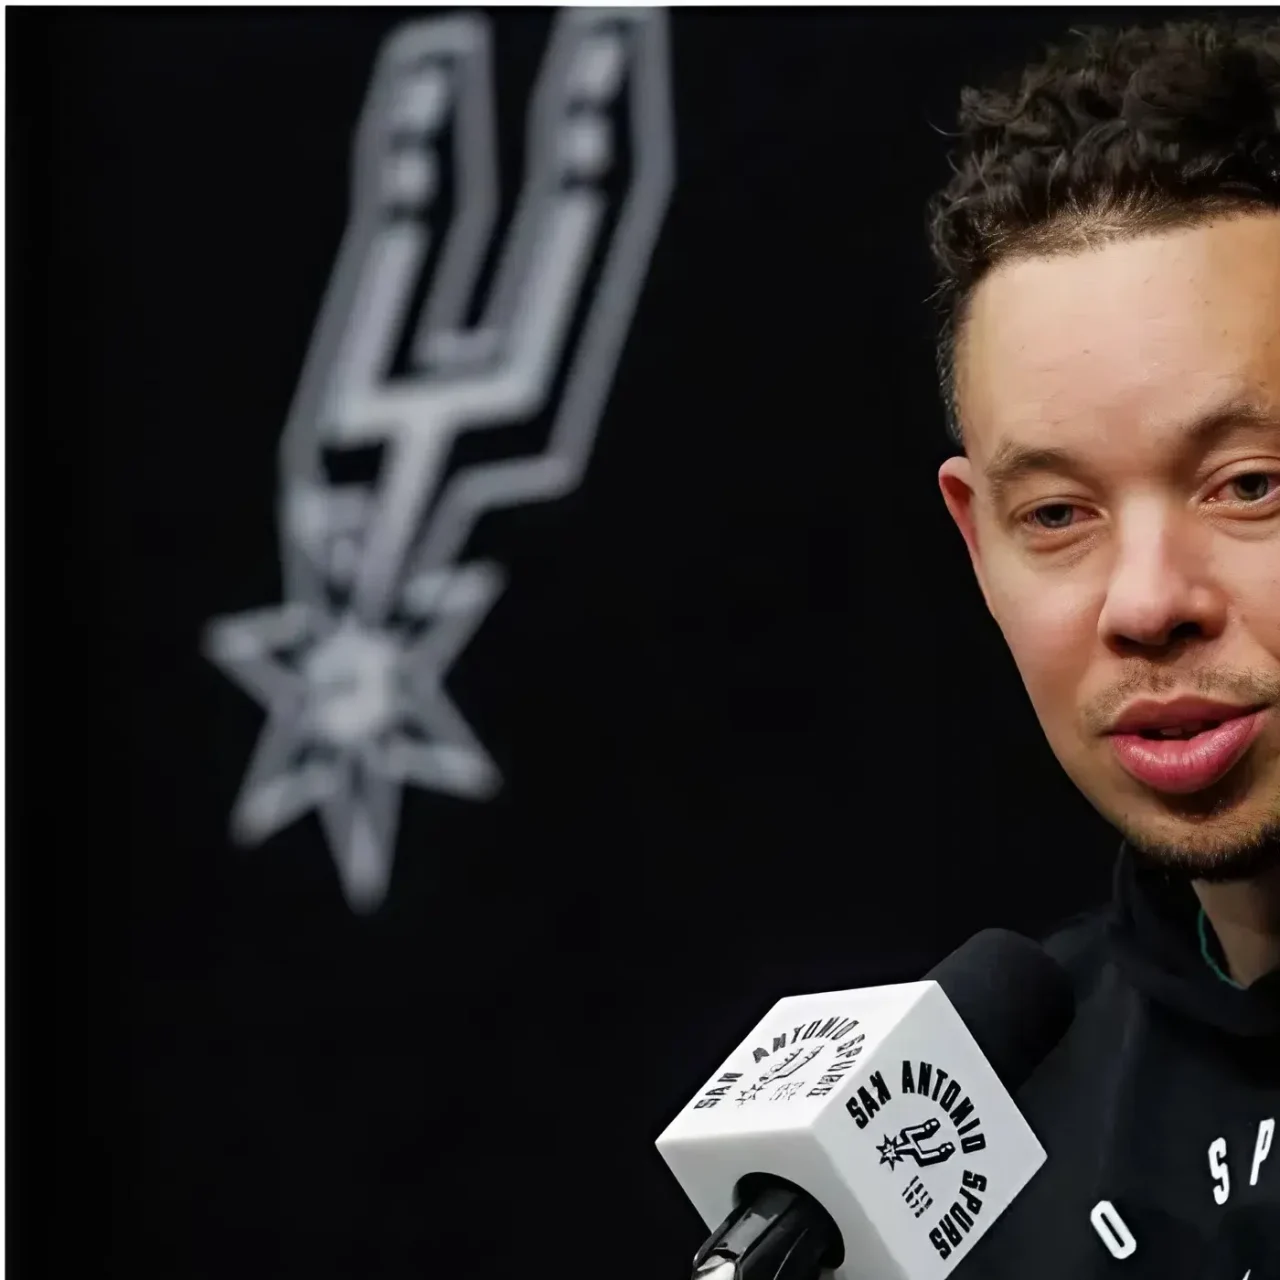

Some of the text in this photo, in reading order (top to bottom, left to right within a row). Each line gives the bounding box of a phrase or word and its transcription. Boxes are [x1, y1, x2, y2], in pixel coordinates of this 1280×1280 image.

[846, 1070, 892, 1129] SAN
[902, 1060, 987, 1155] ANTONIO
[928, 1169, 988, 1260] SPURS
